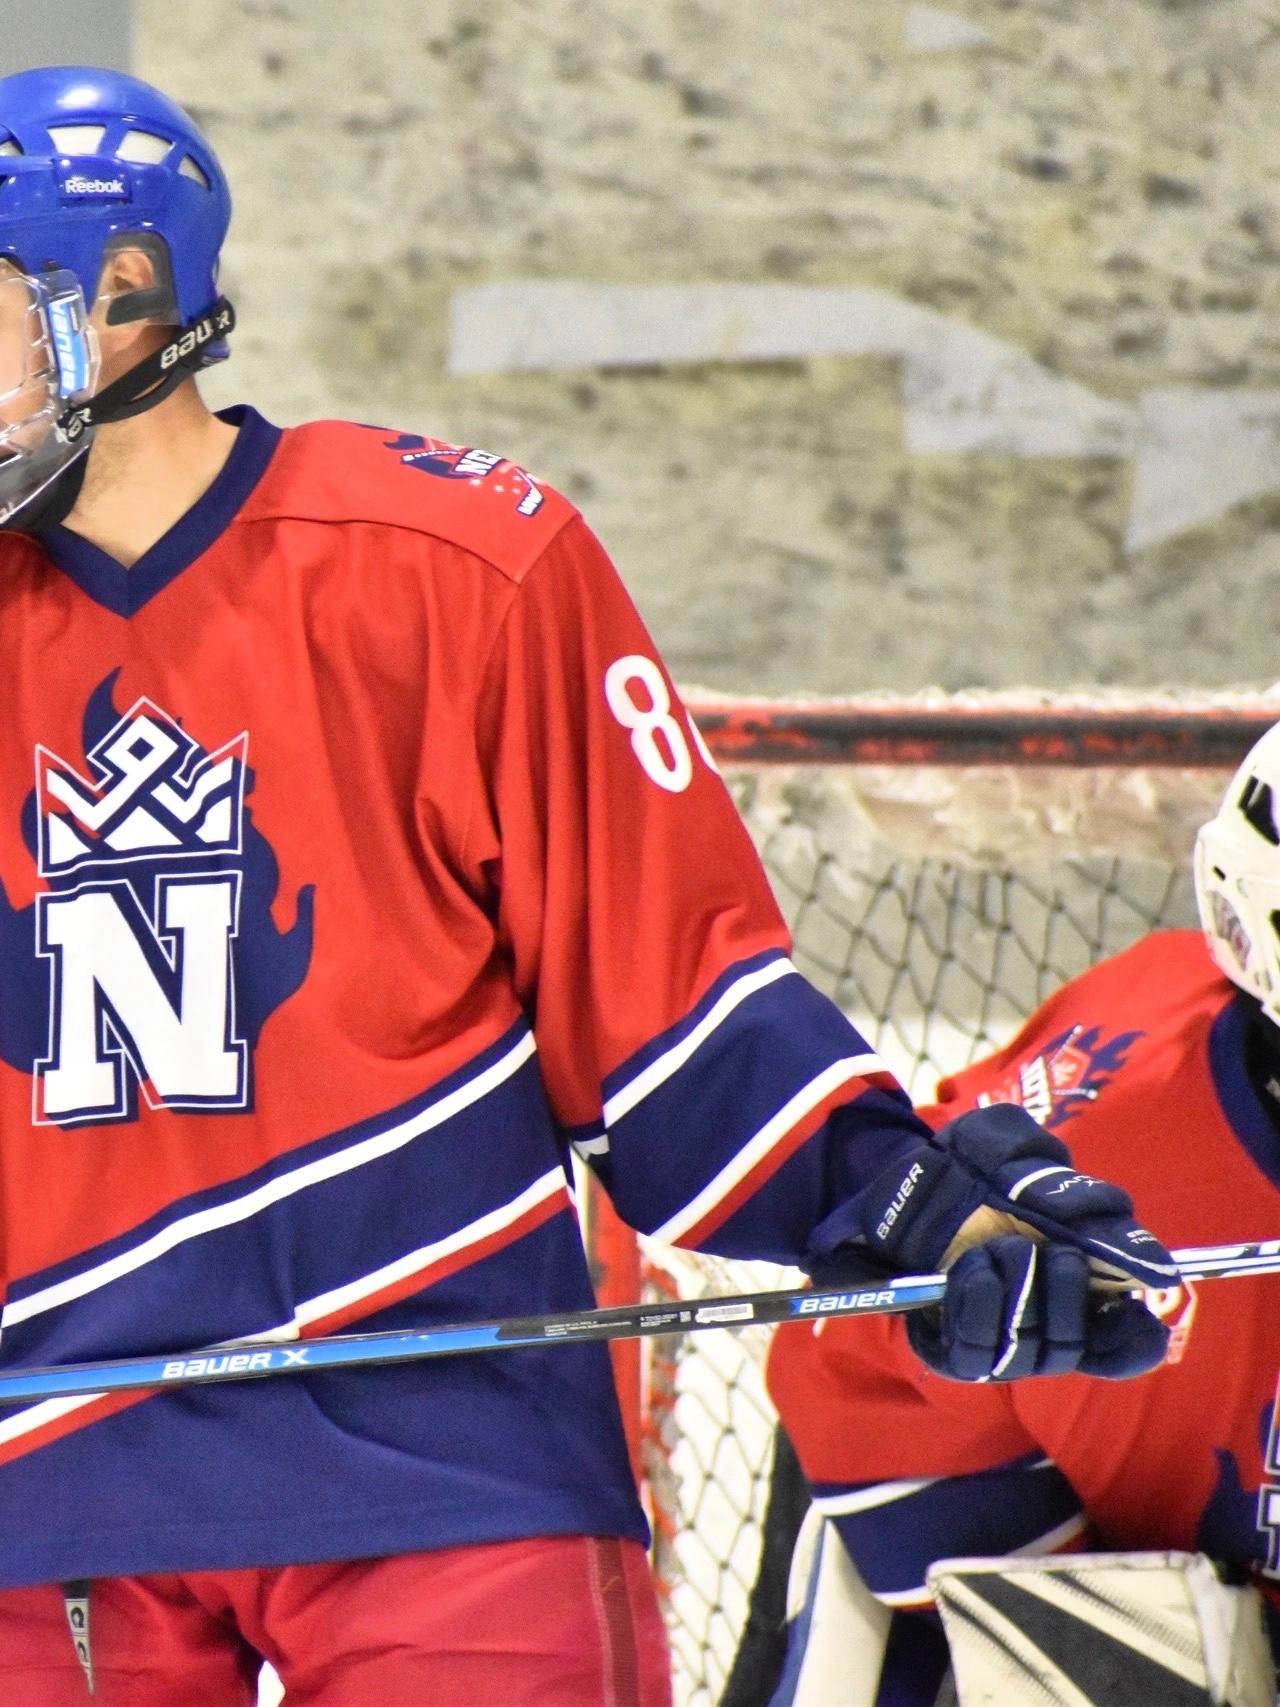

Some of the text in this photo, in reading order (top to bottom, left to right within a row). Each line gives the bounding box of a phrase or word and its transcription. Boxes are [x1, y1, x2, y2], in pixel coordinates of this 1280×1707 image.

[64, 178, 124, 194] Reebok
[604, 654, 721, 793] 8
[42, 879, 240, 1115] N
[799, 1290, 896, 1314] BAUER
[161, 1348, 311, 1379] BAUER X
